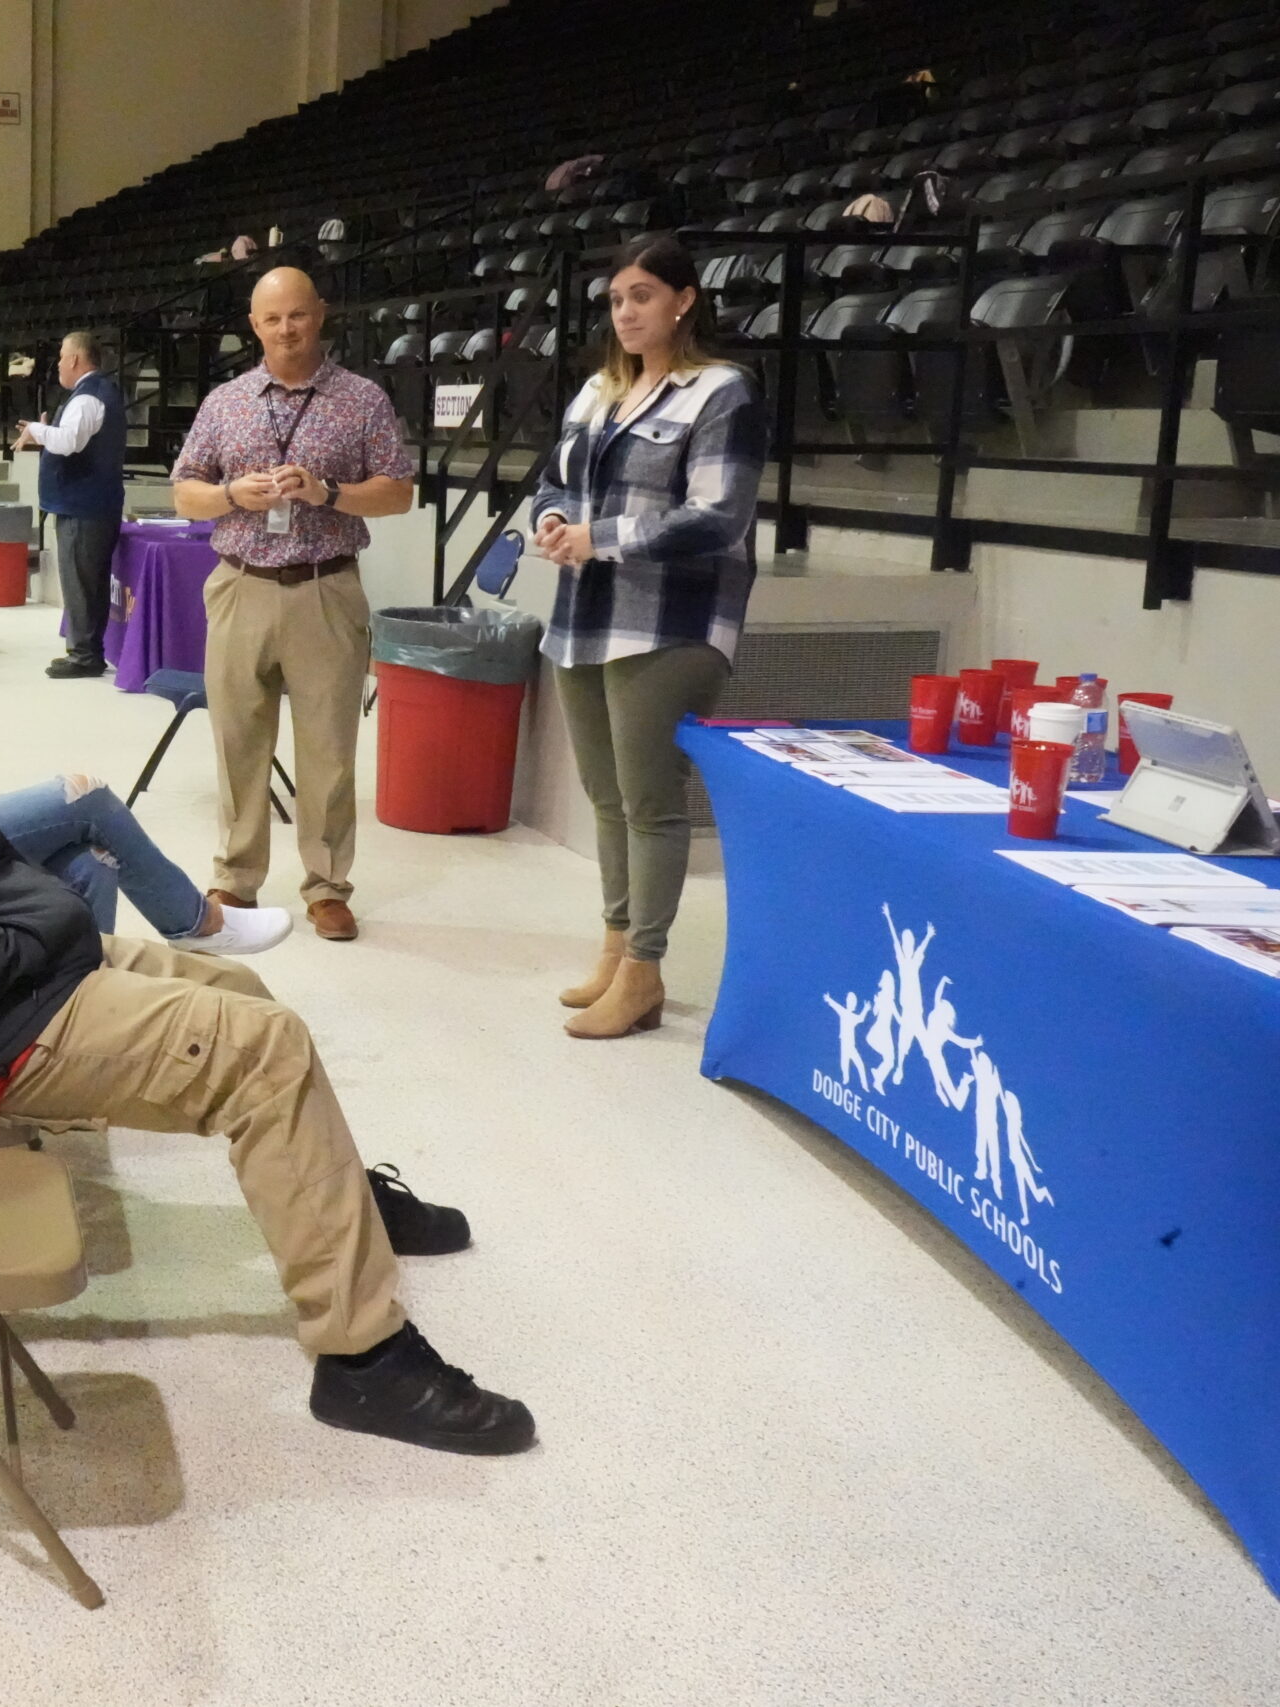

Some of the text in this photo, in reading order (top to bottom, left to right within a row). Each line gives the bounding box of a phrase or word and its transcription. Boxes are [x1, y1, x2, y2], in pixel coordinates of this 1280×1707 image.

[813, 1068, 1063, 1294] DODGE CITY PUBLIC SCHOOLS
